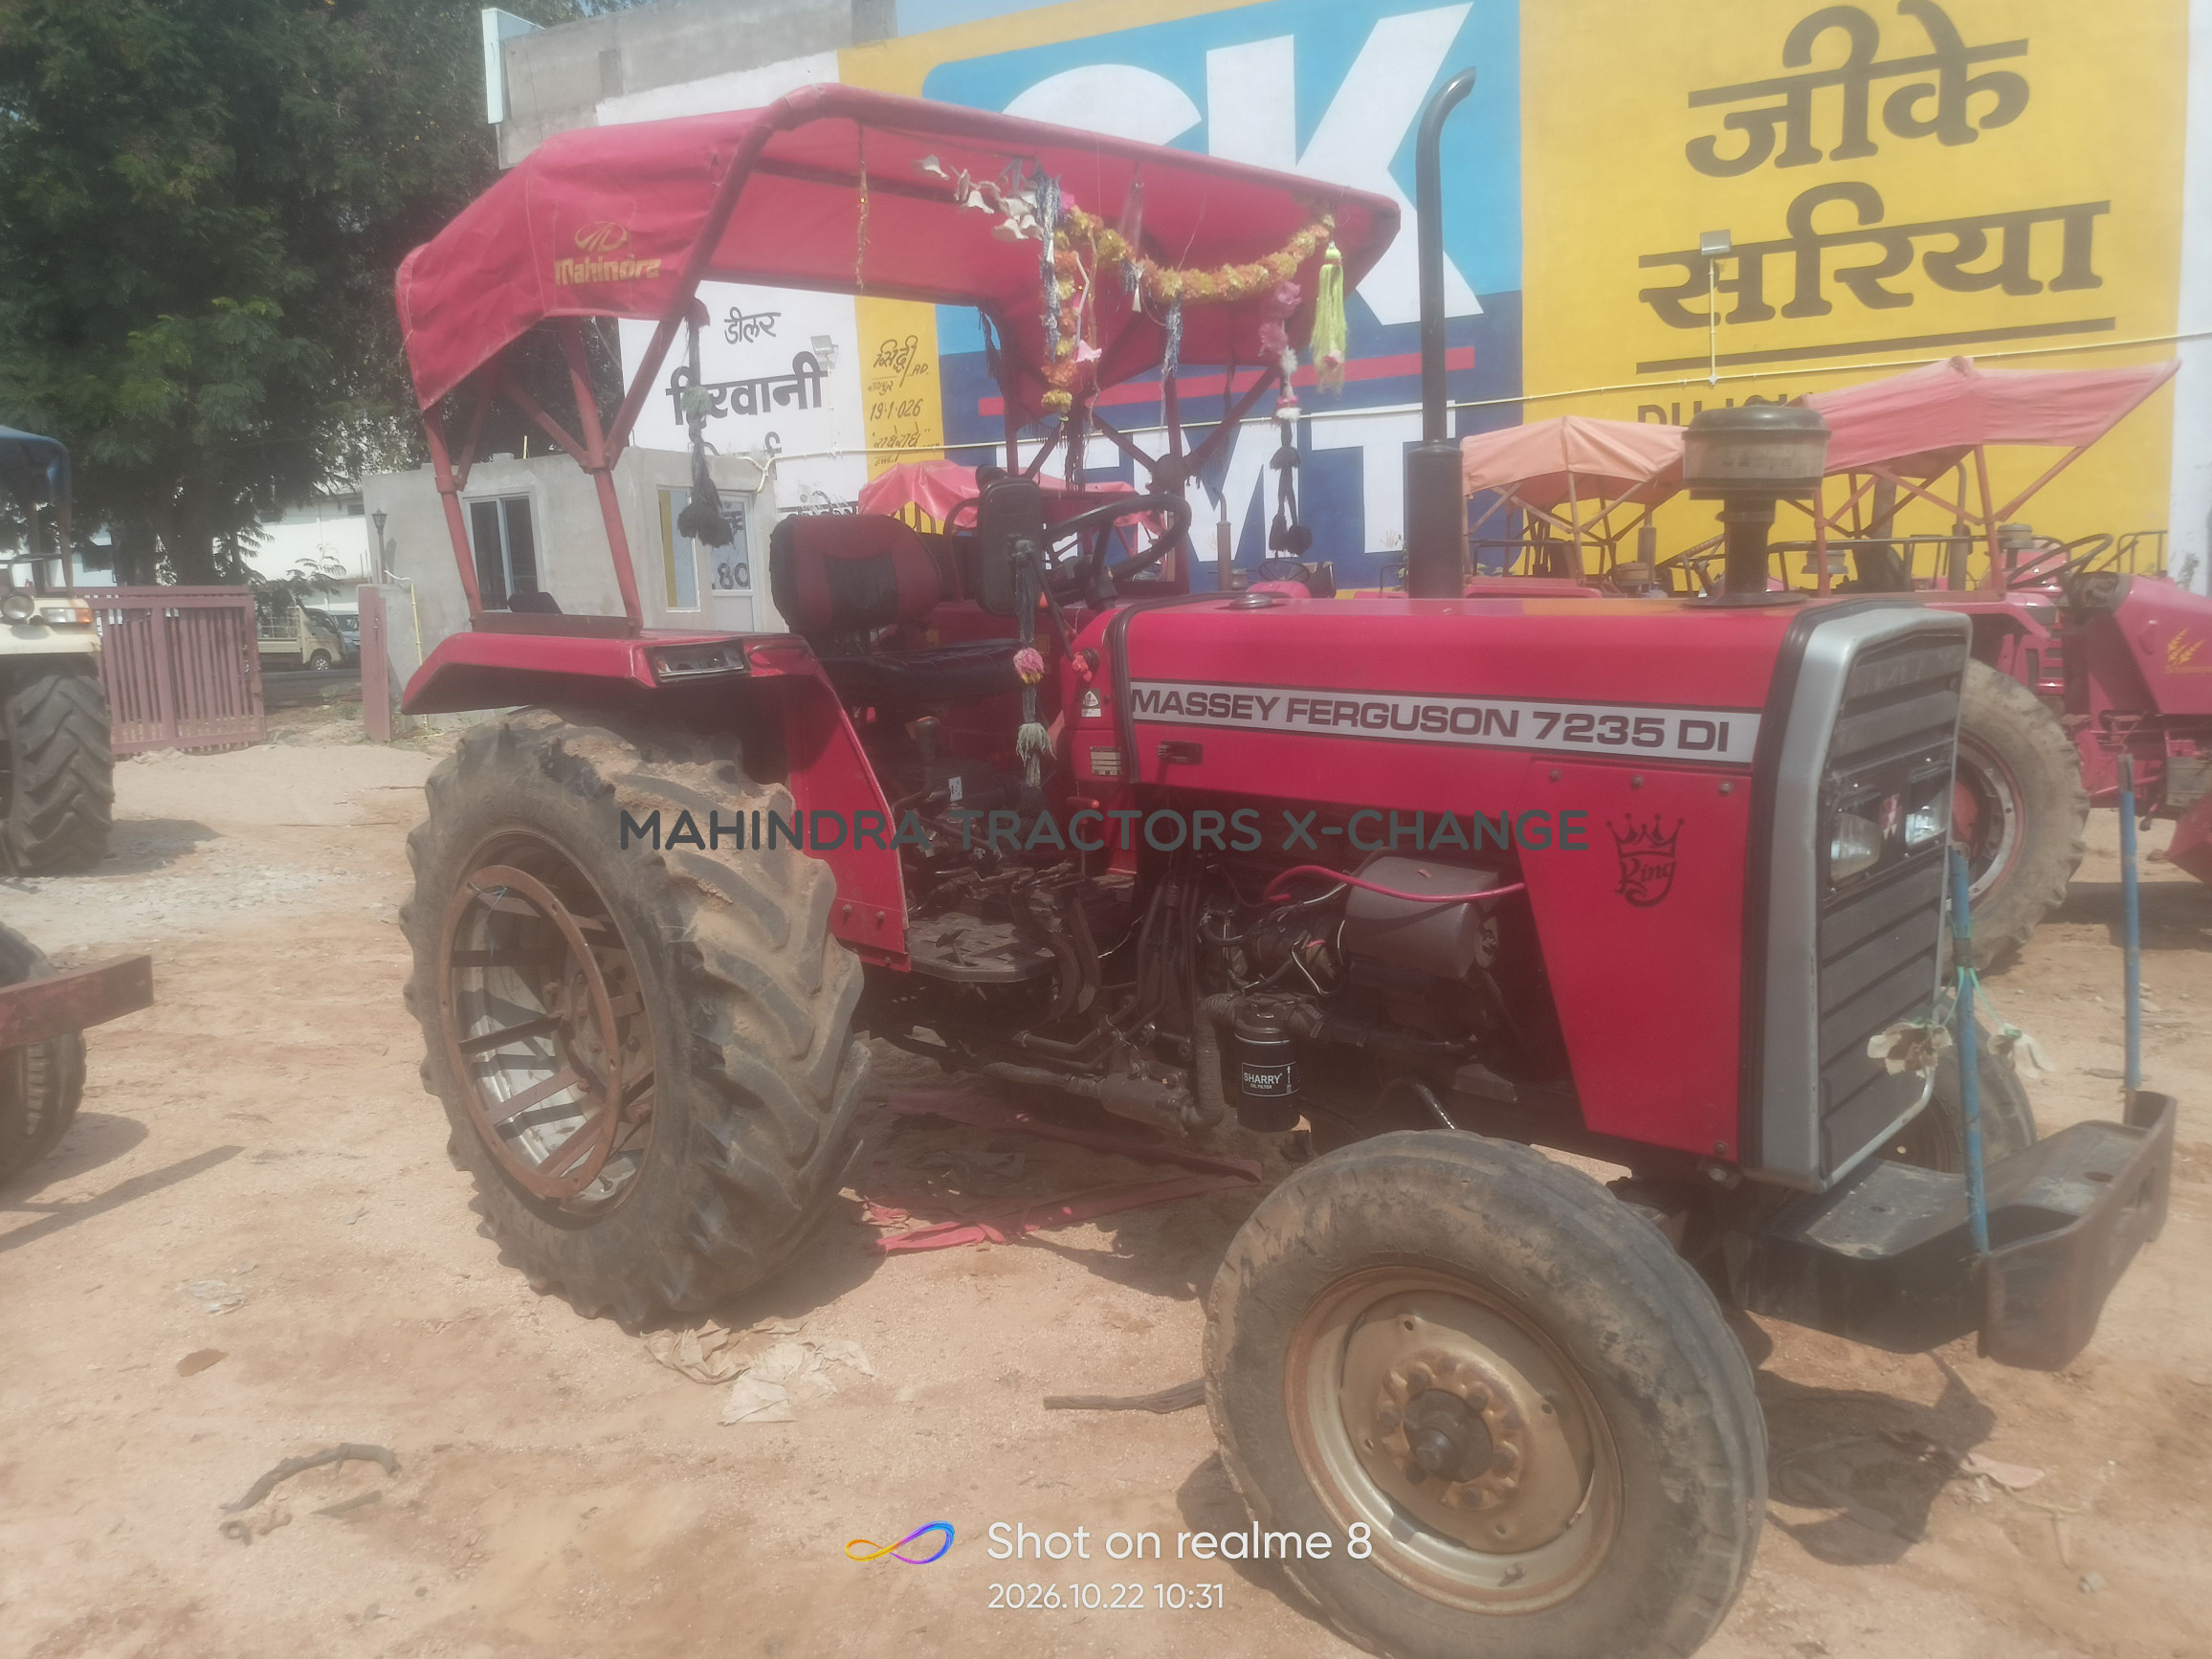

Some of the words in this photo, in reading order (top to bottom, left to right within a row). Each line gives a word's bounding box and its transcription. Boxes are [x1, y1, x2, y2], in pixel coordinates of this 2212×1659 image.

[1686, 0, 2030, 178] जीके
[554, 255, 662, 286] Mahindra
[1638, 181, 2112, 330] सरिया
[723, 306, 781, 345] डीलर
[1132, 688, 1281, 721] MASSEY
[1285, 699, 1519, 738] FERGUSON
[1531, 711, 1666, 748] 7235
[1677, 719, 1729, 752] DI
[1244, 1073, 1280, 1084] SHARRY
